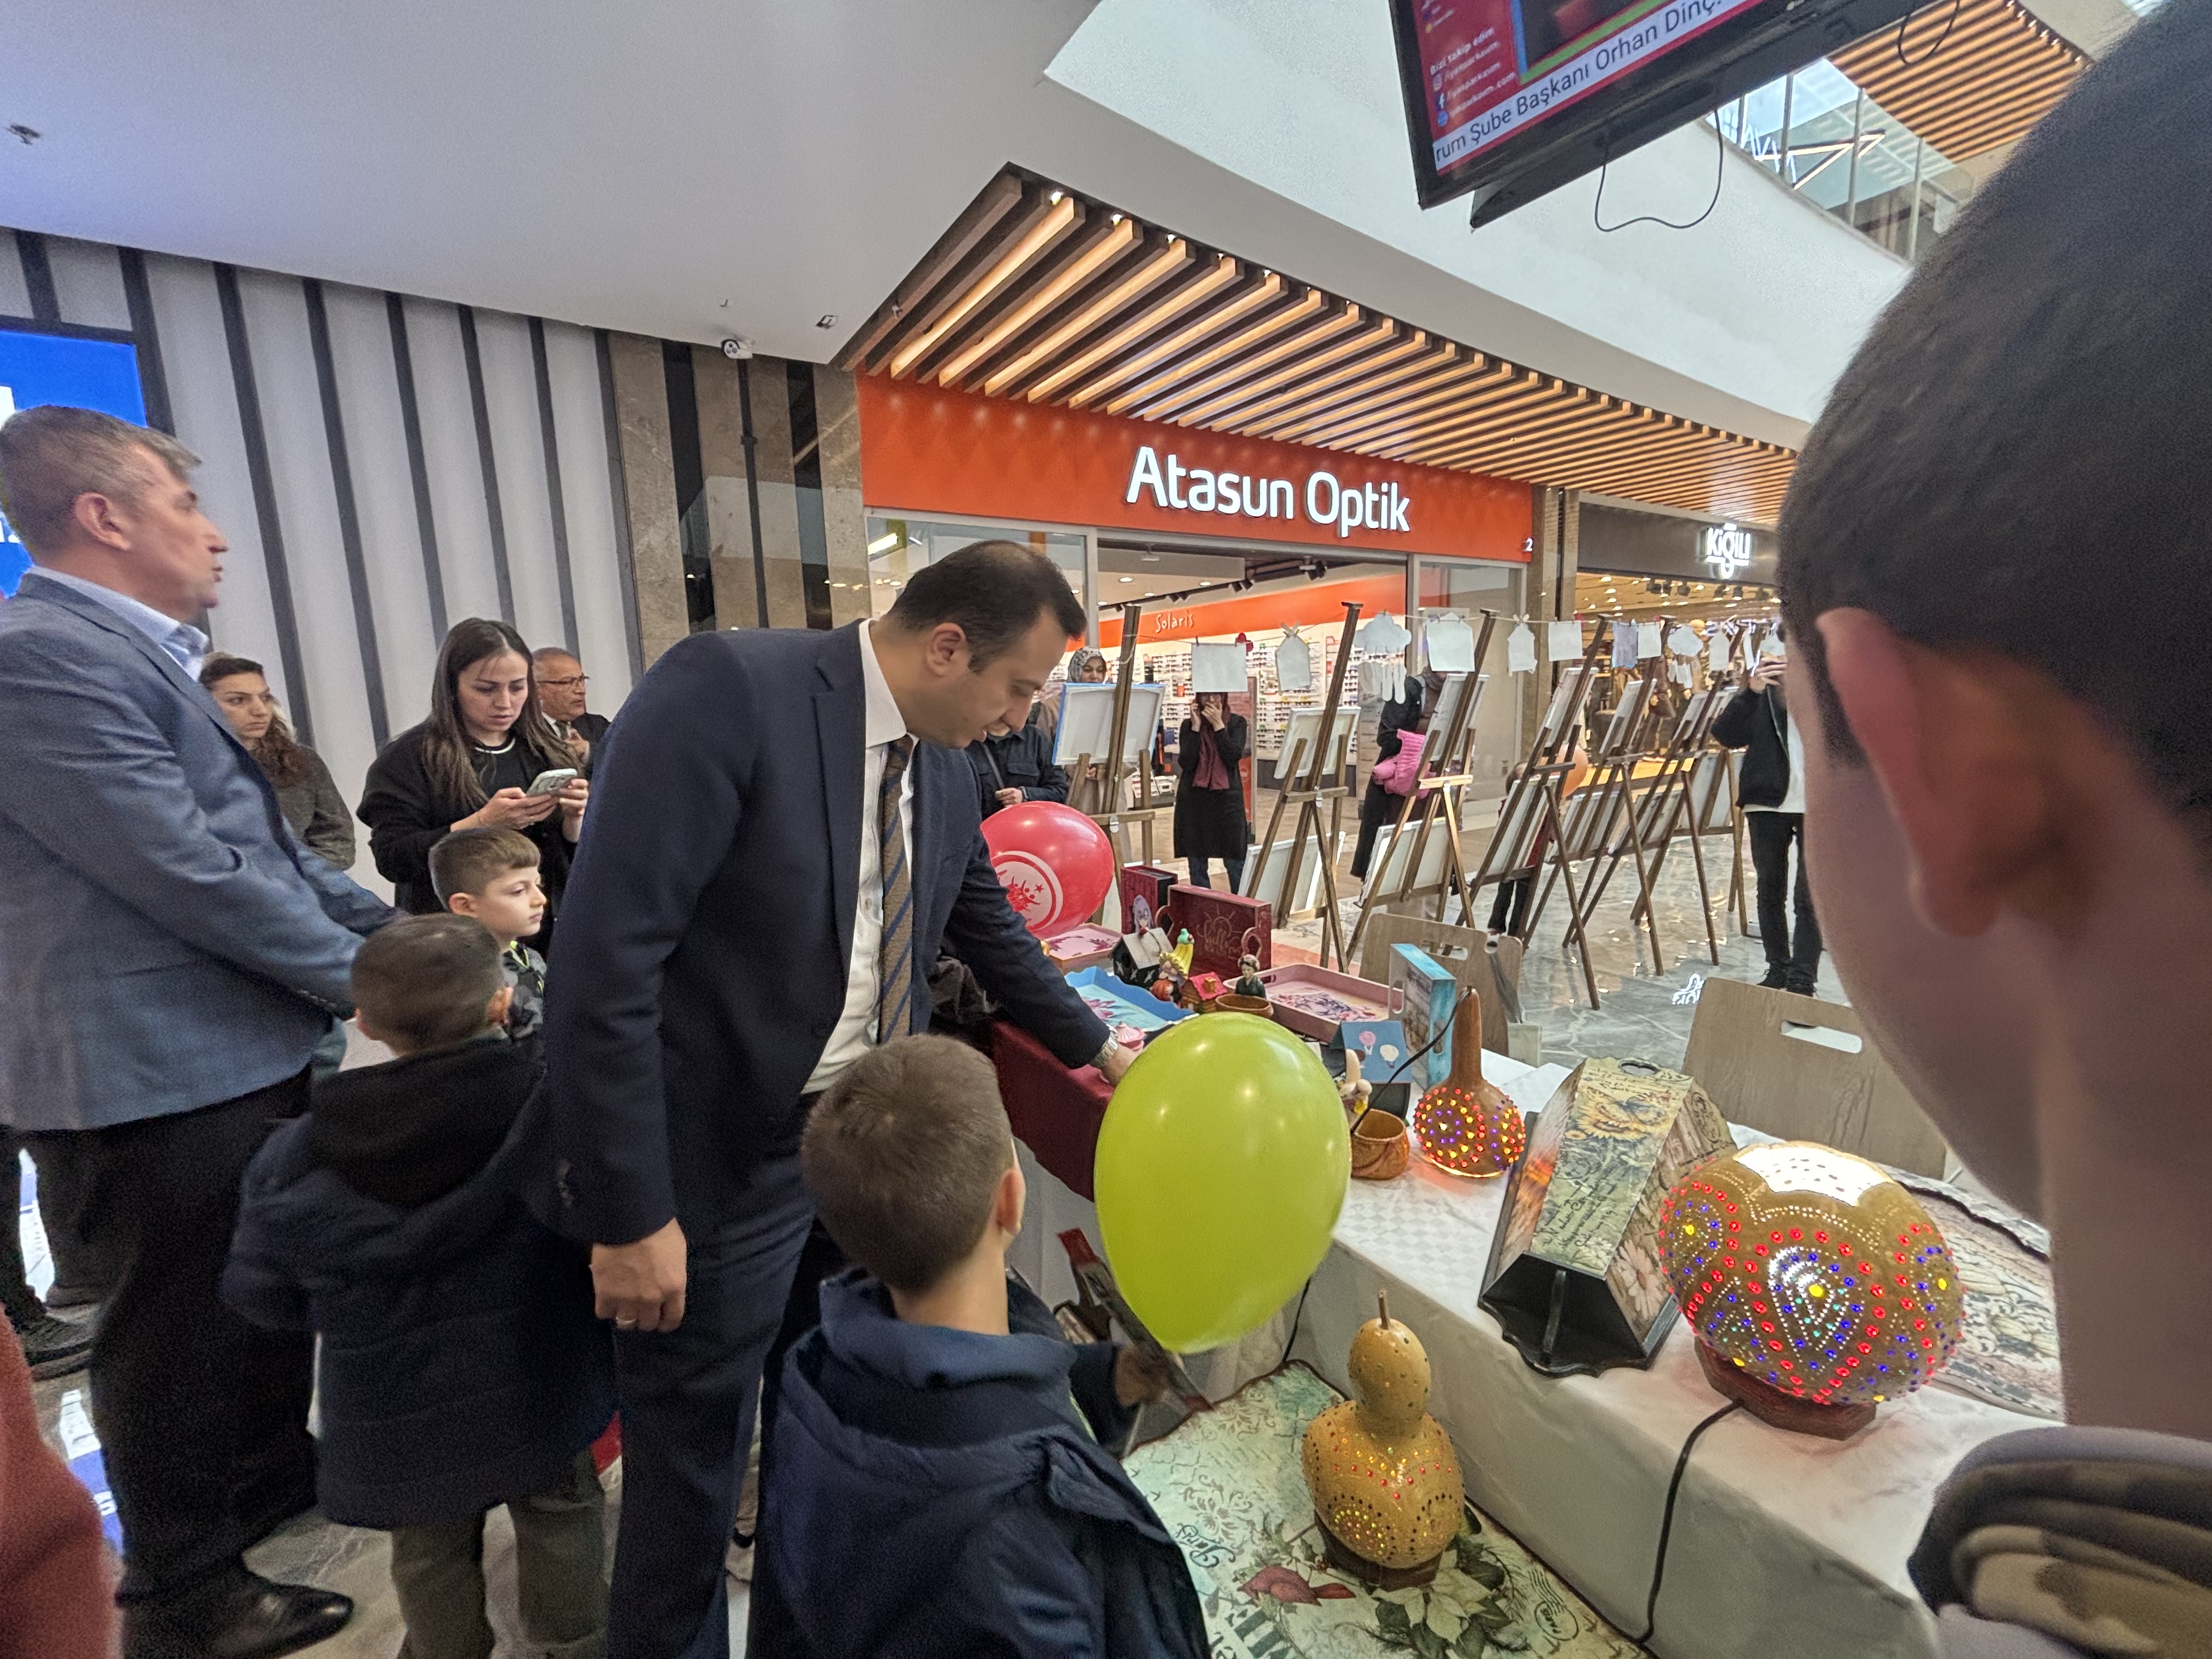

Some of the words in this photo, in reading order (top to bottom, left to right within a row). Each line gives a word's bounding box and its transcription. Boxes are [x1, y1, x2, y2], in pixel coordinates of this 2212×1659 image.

[1436, 135, 1466, 162] rum
[1470, 110, 1511, 145] Şube
[1516, 63, 1589, 116] Başkanı
[1595, 25, 1658, 70] Orhan
[1664, 0, 1722, 33] Dinç
[1125, 445, 1294, 520] Atasun
[1306, 471, 1410, 538] Optik
[1525, 537, 1533, 552] 2
[1155, 610, 1193, 633] Solaris
